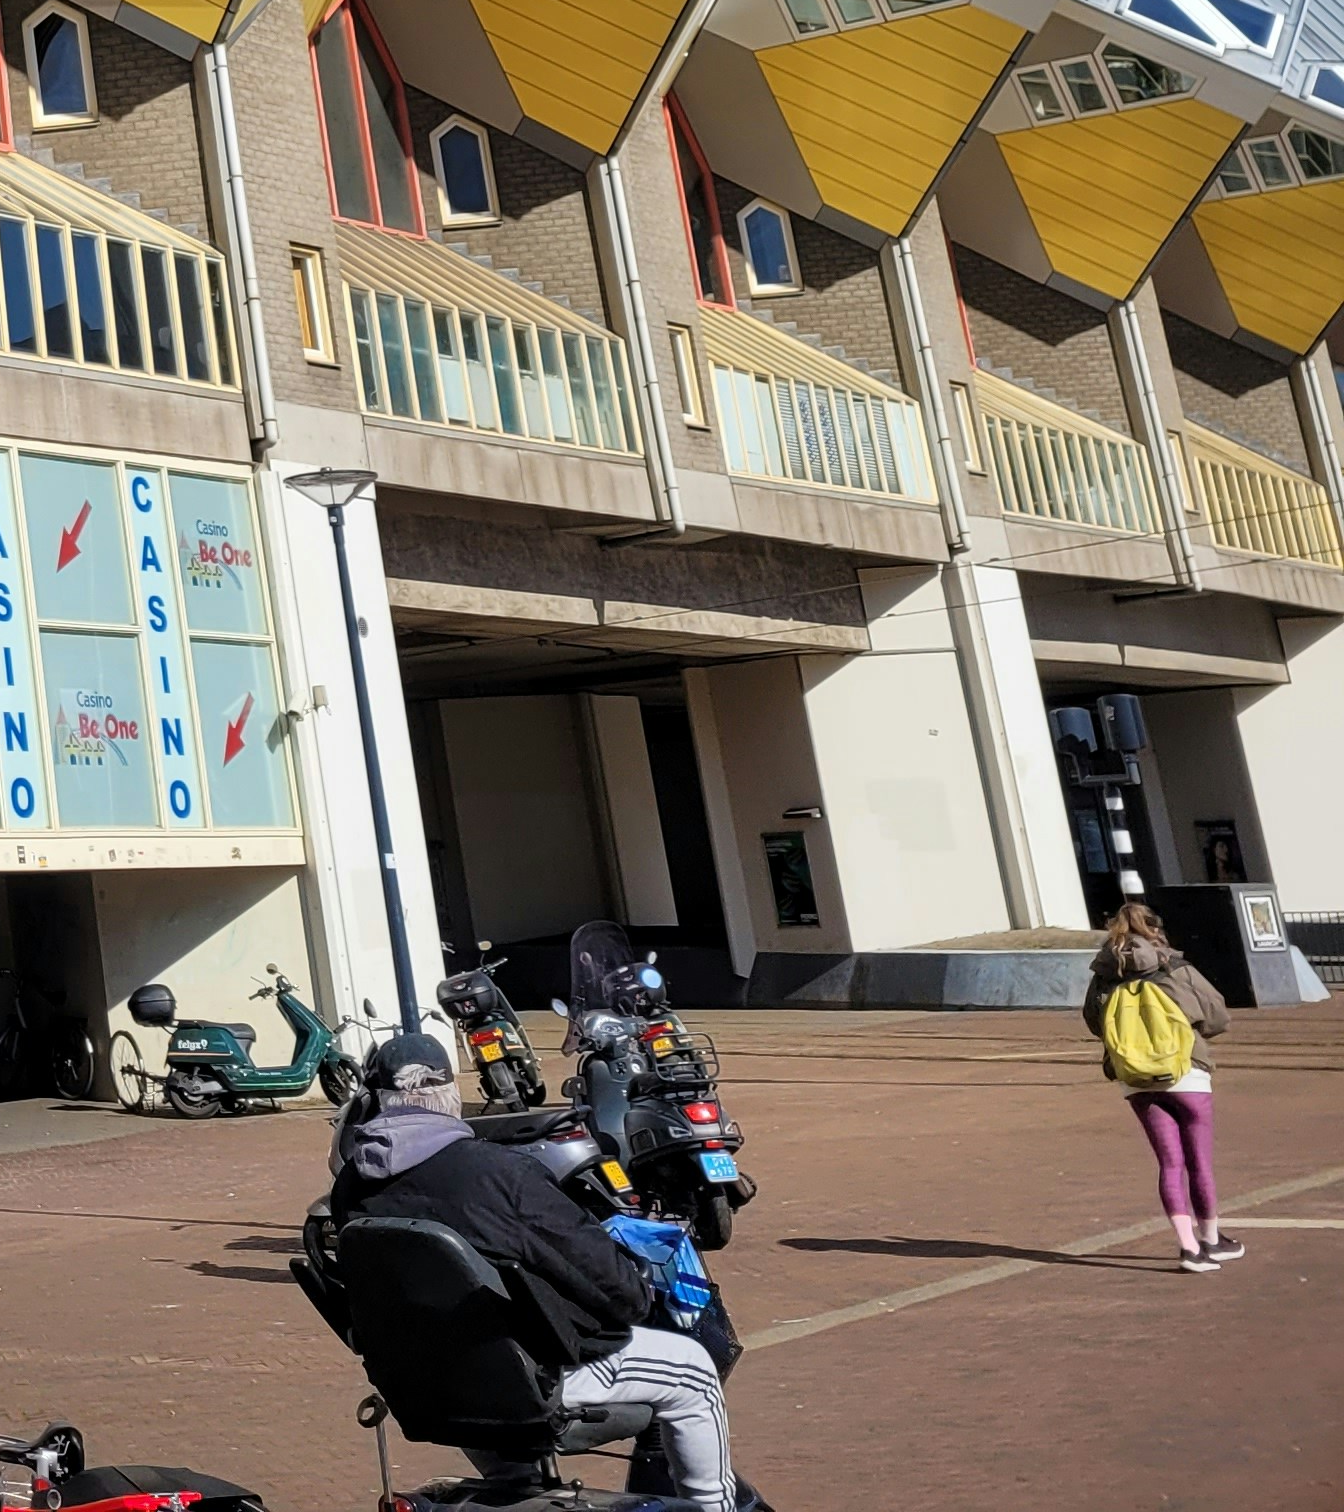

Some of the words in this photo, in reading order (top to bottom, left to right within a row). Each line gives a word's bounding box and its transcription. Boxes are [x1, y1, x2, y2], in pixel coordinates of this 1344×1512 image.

[196, 519, 229, 537] Casino
[198, 539, 219, 564] Be
[221, 541, 252, 567] One
[131, 476, 193, 819] CASINO
[76, 691, 113, 708] Casino
[78, 713, 100, 739] Be
[105, 713, 139, 740] One
